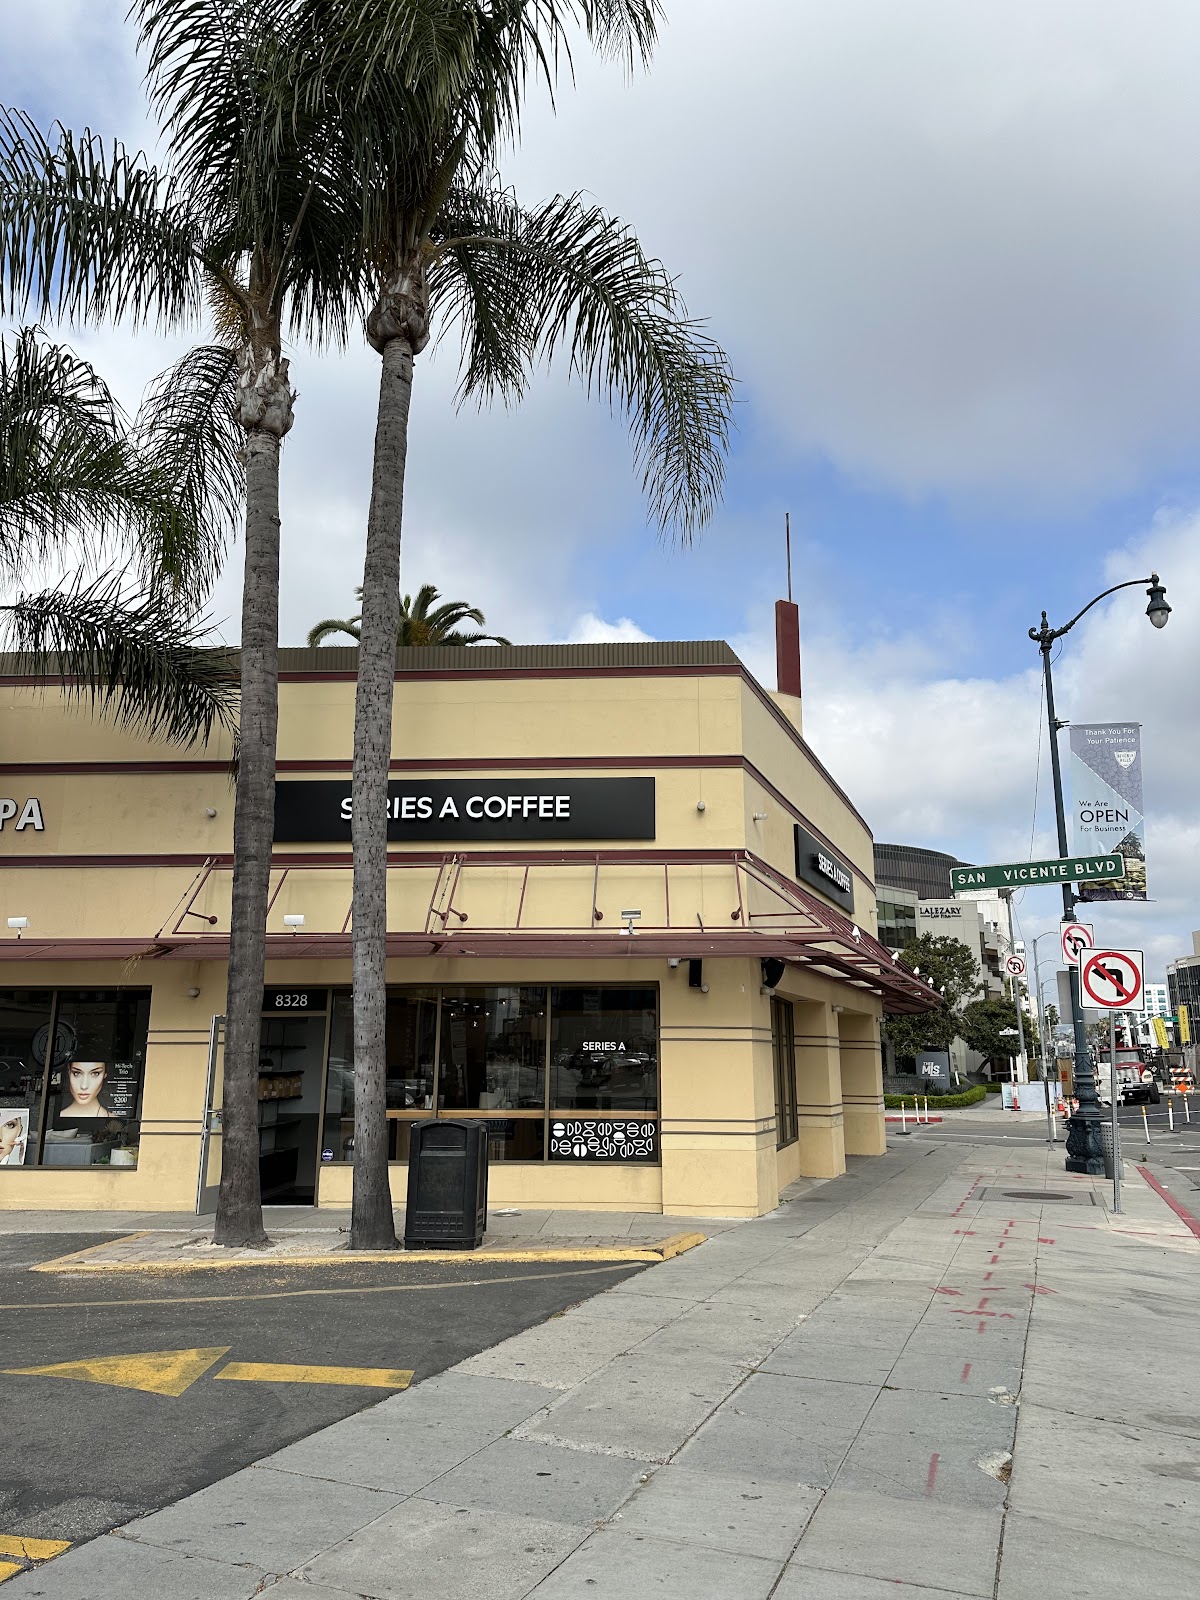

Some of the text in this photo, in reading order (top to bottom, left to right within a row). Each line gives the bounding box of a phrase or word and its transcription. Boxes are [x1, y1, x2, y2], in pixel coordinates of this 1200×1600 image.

[340, 795, 571, 819] SIES A COFFEE
[1080, 809, 1129, 823] OPEN
[957, 860, 1116, 885] SAN VICENTE BLVD
[275, 994, 308, 1007] 8328
[582, 1041, 626, 1051] SERIES A
